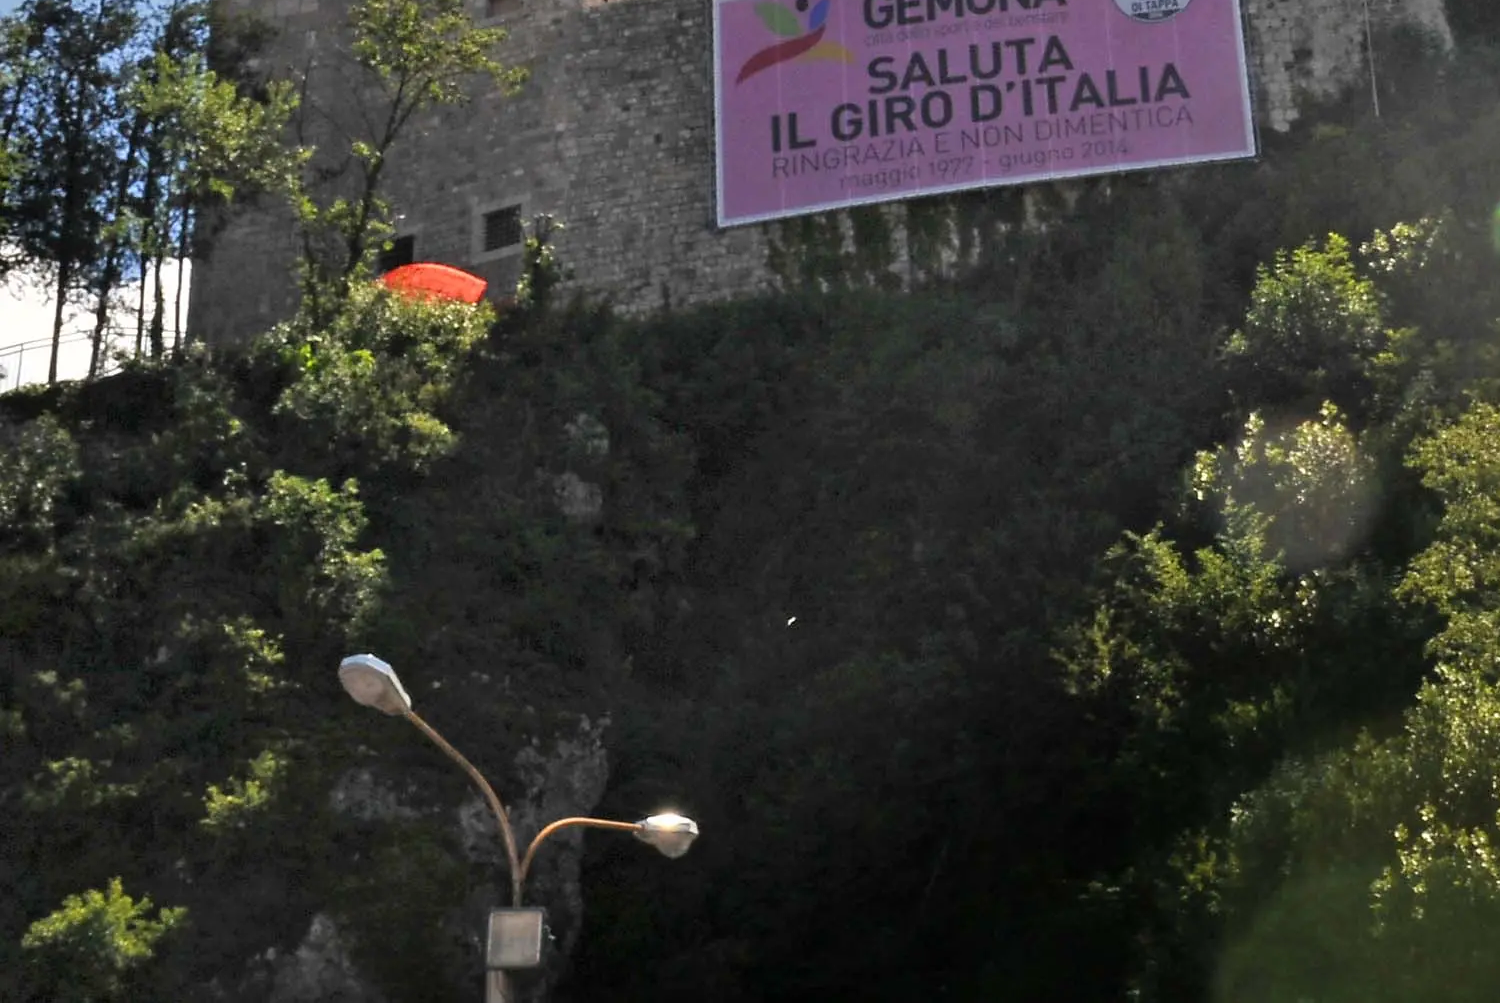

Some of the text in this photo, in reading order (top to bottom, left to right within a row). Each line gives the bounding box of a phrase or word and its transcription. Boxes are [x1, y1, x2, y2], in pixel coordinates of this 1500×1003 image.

[867, 35, 1073, 95] SALUTA
[771, 62, 1191, 153] IL GIRO D'ITALIA
[772, 104, 1193, 179] RINGRAZIA E NON DIMENTICA
[839, 165, 921, 190] maggio
[928, 155, 974, 179] 1977
[999, 147, 1075, 171] giugno
[1081, 139, 1129, 159] 2014
